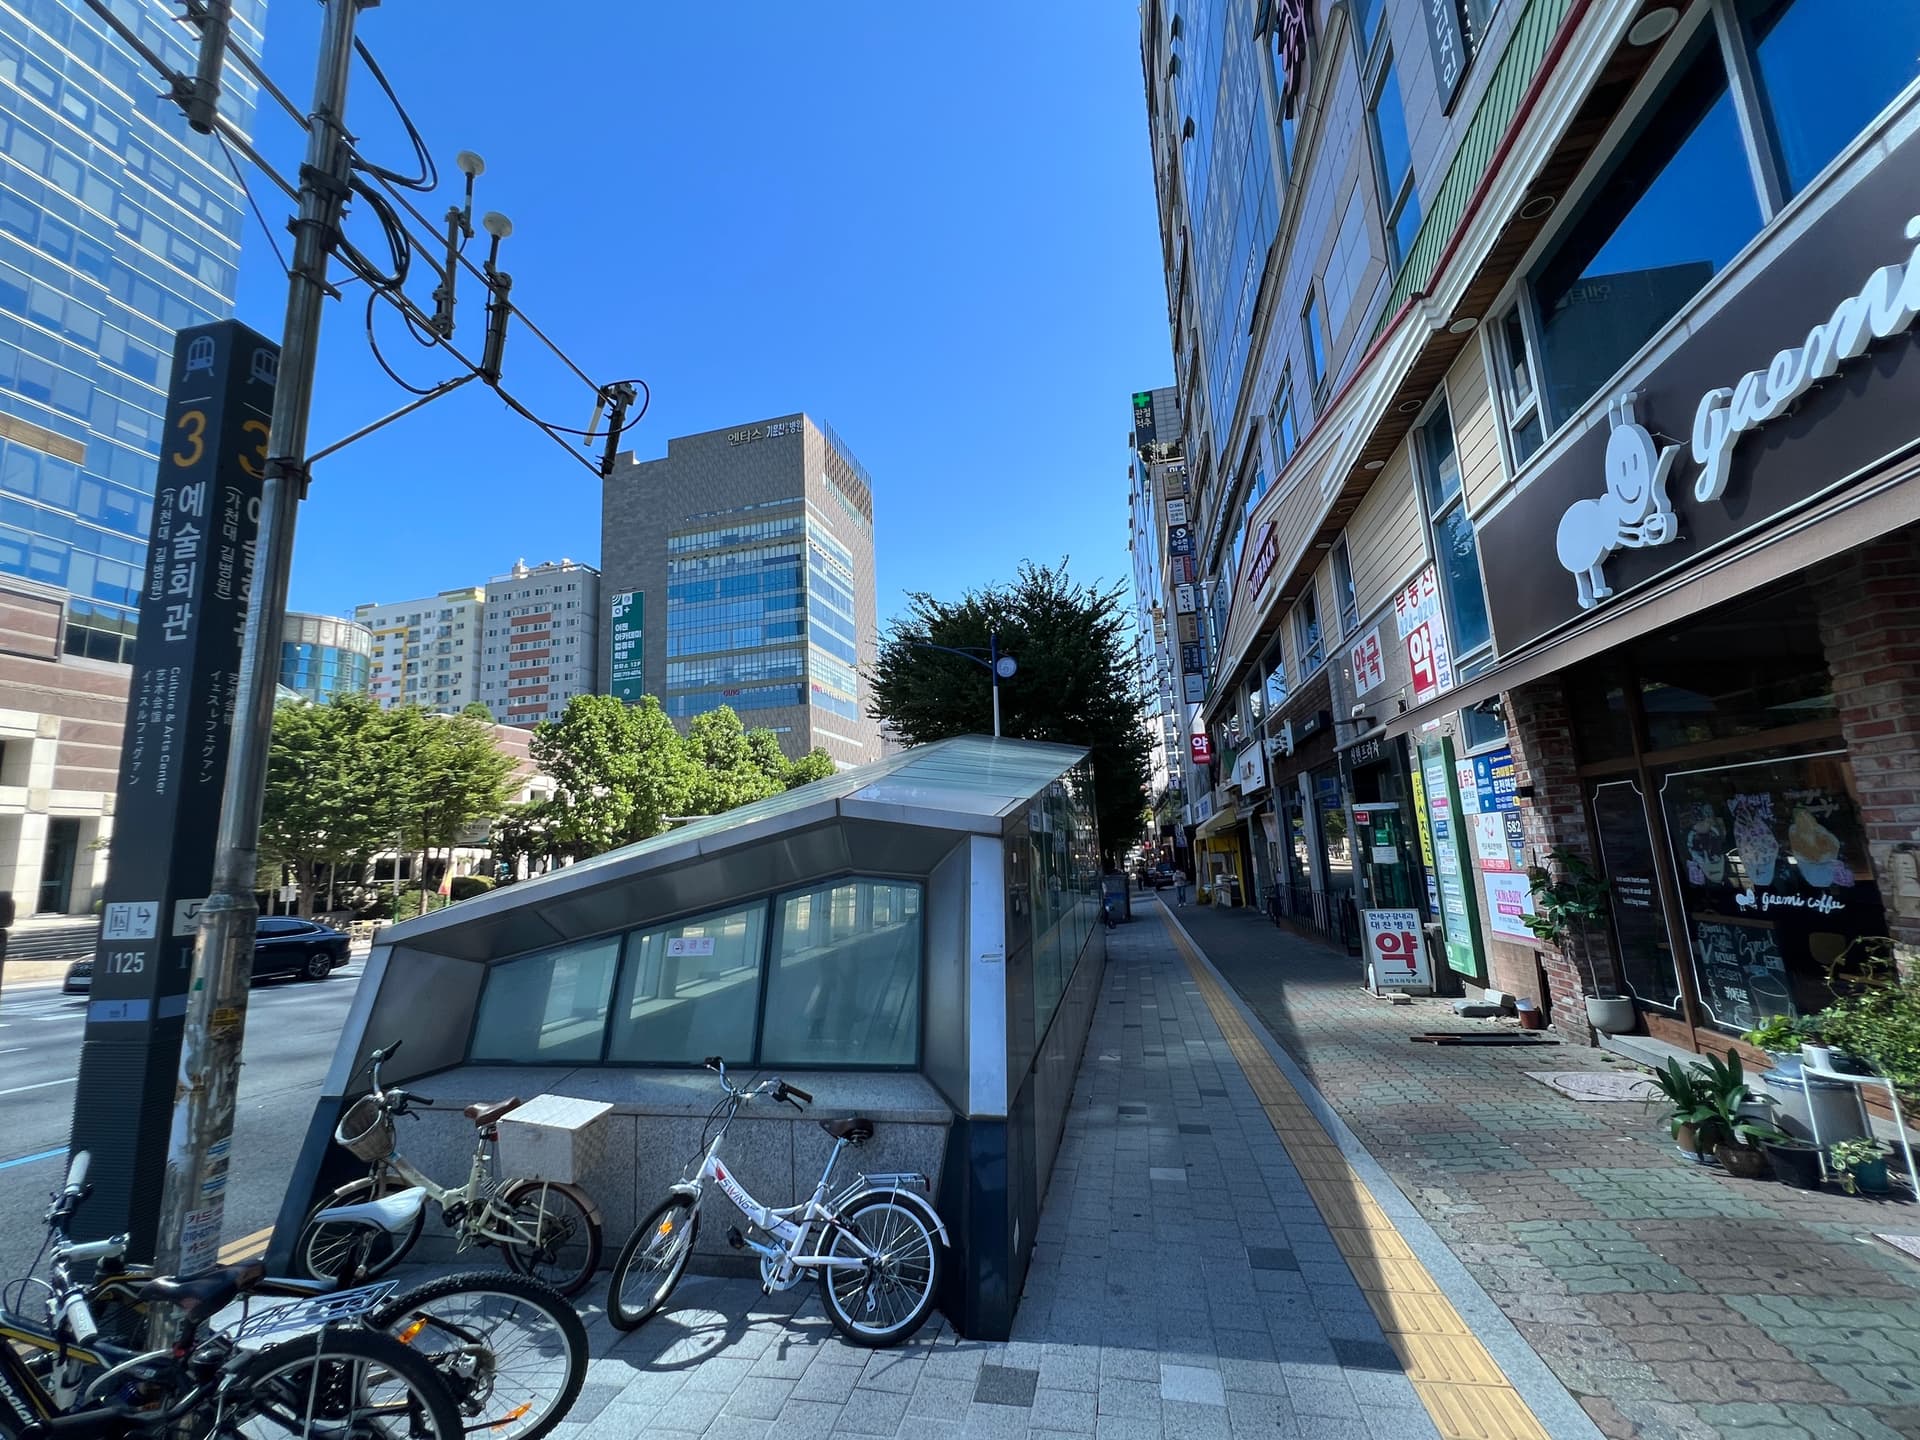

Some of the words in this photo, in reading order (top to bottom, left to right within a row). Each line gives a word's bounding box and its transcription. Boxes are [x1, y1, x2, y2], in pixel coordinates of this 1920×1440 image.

[173, 410, 206, 468] 3
[162, 481, 206, 641] 예술회관
[1395, 567, 1435, 618] 부동산
[1353, 634, 1382, 689] 약국
[1409, 628, 1433, 684] 약
[1434, 633, 1450, 688] 사진관
[167, 667, 181, 710] Culture
[161, 725, 175, 752] Arts
[1192, 735, 1209, 754] 약
[156, 754, 170, 795] Center
[1506, 821, 1522, 833] 582
[1807, 893, 1846, 914] coffee
[1375, 931, 1418, 969] 약
